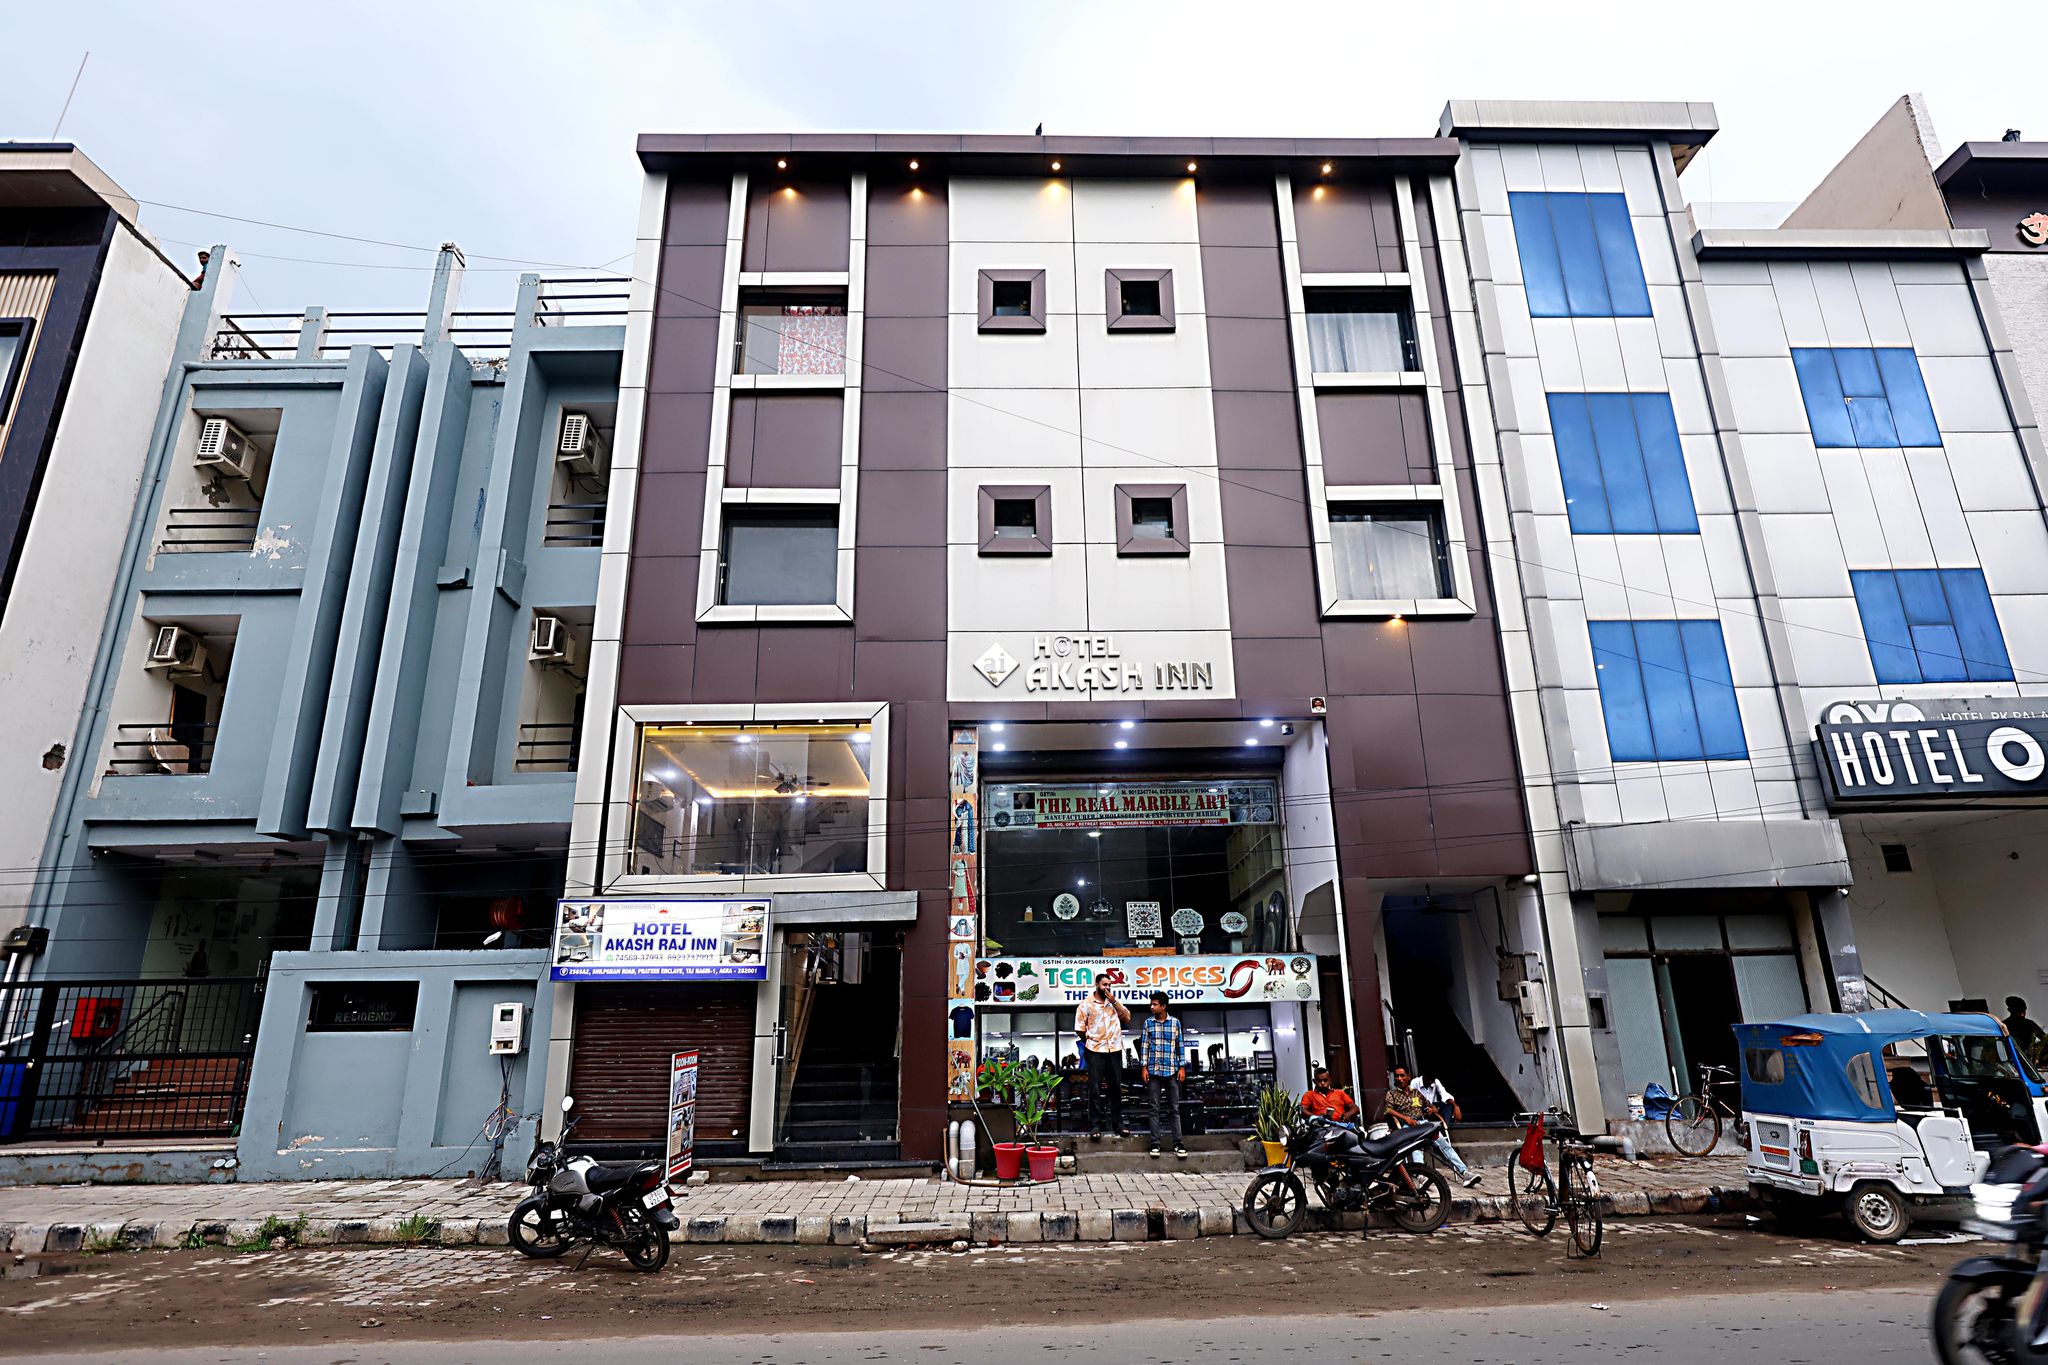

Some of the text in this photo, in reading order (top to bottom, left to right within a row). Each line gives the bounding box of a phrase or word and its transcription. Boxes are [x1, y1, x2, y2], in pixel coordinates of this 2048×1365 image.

[1033, 636, 1120, 660] HOTEL
[1025, 661, 1213, 692] AKASH INN
[1830, 729, 1984, 787] HOTEL
[1037, 794, 1227, 813] THE REAL MARBLE ART
[633, 923, 692, 935] HOTEL
[605, 938, 717, 951] AKASH RAJ INN
[1045, 966, 1226, 987] TEA & SPICES
[1065, 990, 1089, 1000] THE
[1167, 989, 1204, 1000] SHOP
